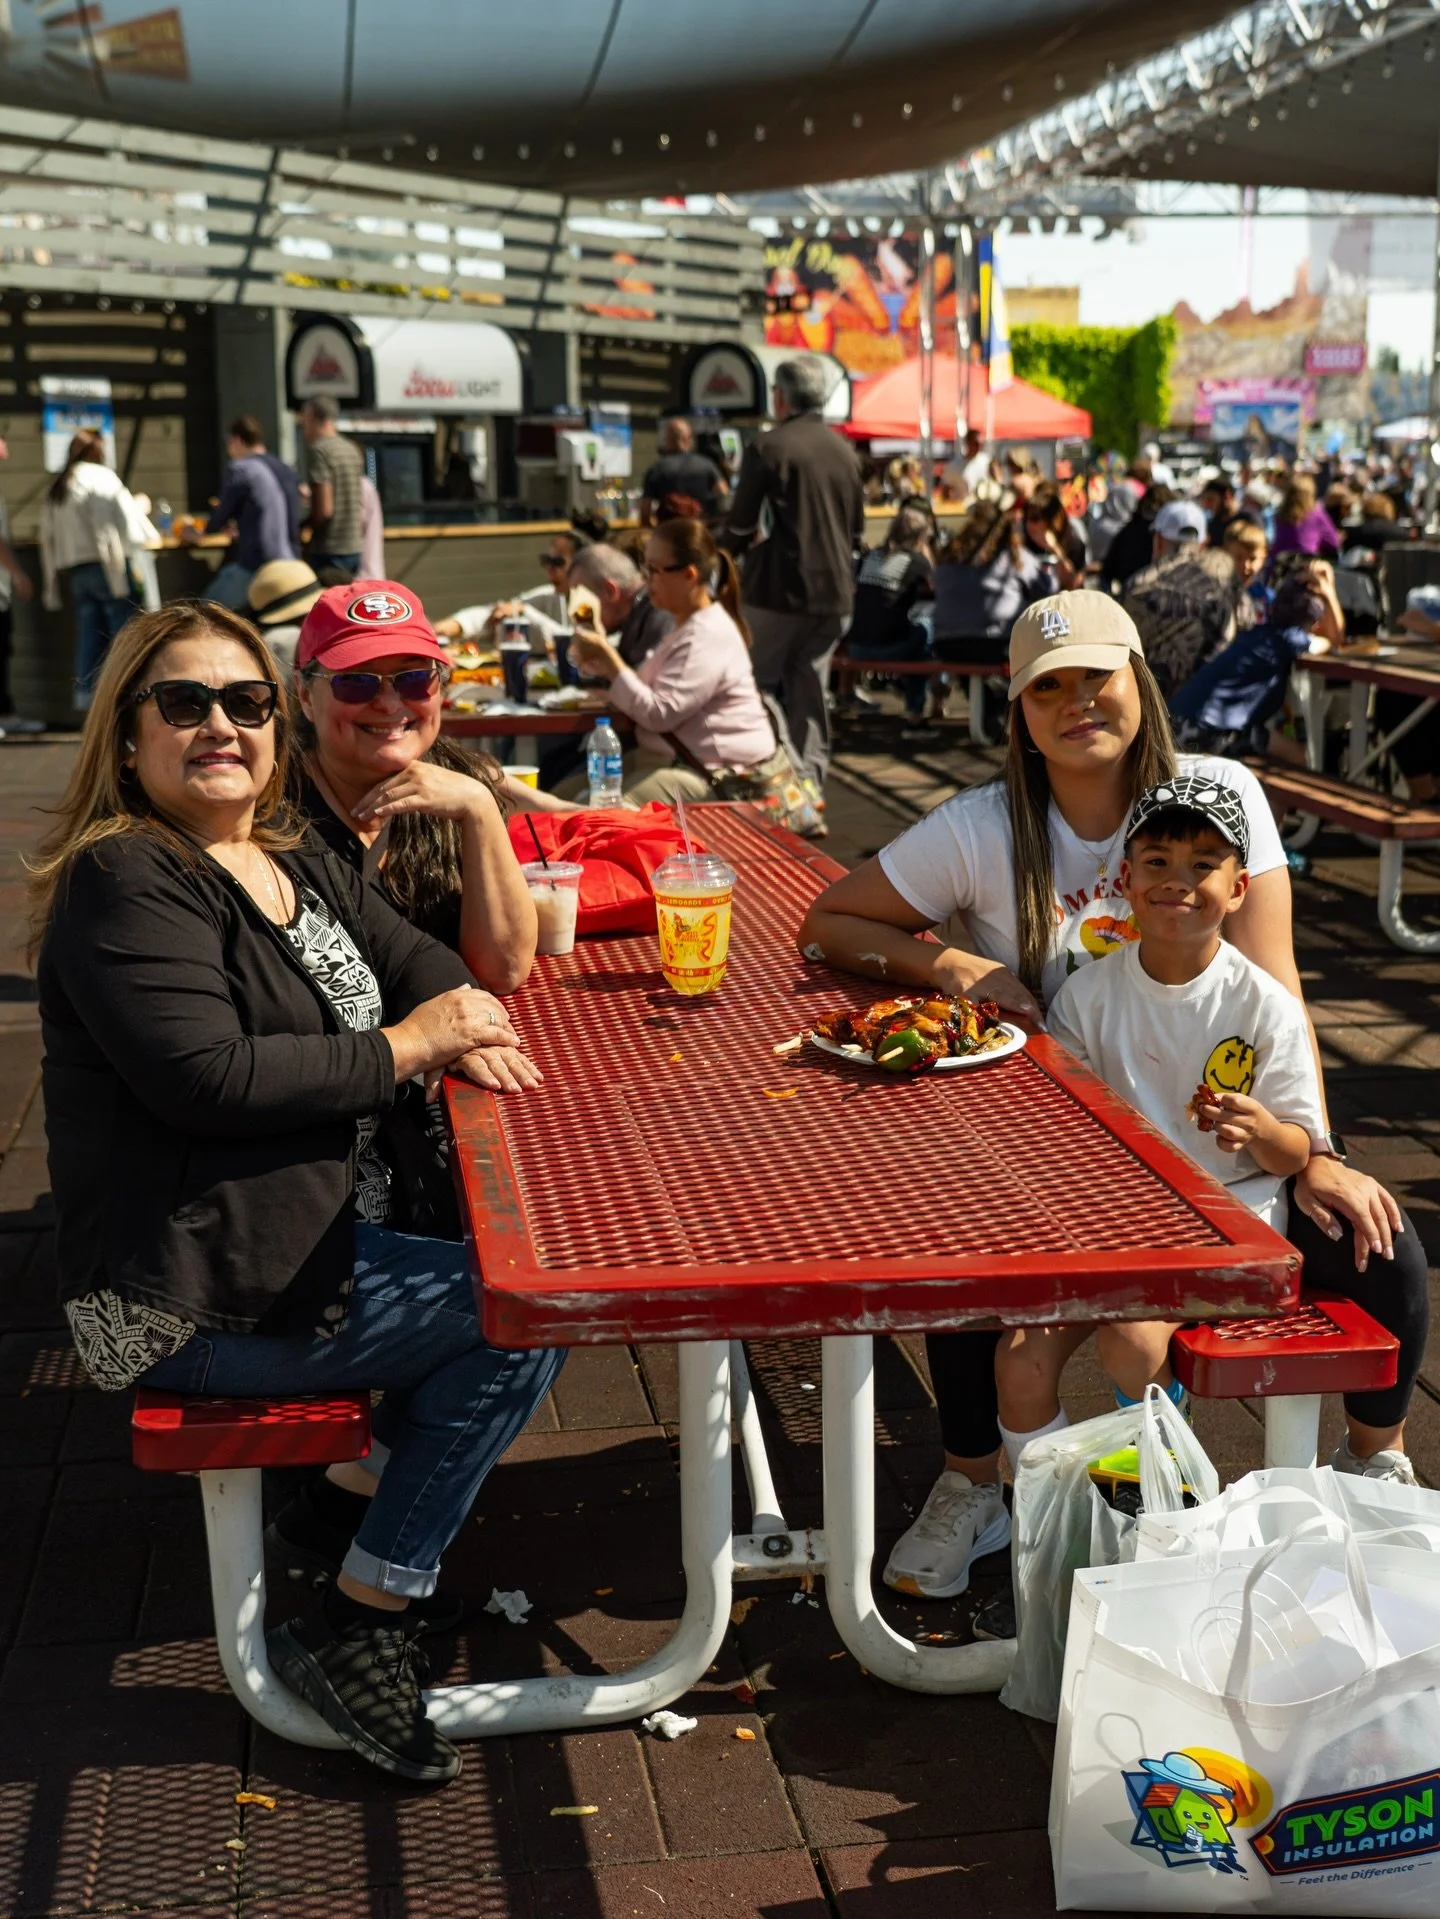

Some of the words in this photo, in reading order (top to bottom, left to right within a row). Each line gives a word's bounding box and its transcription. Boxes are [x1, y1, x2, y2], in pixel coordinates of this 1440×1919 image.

[1040, 607, 1071, 640] LA
[1286, 1788, 1433, 1847] TYSON
[1283, 1822, 1433, 1863] INSULATION
[1298, 1874, 1324, 1885] Feel
[1326, 1872, 1348, 1883] the
[1351, 1863, 1415, 1880] Difference
